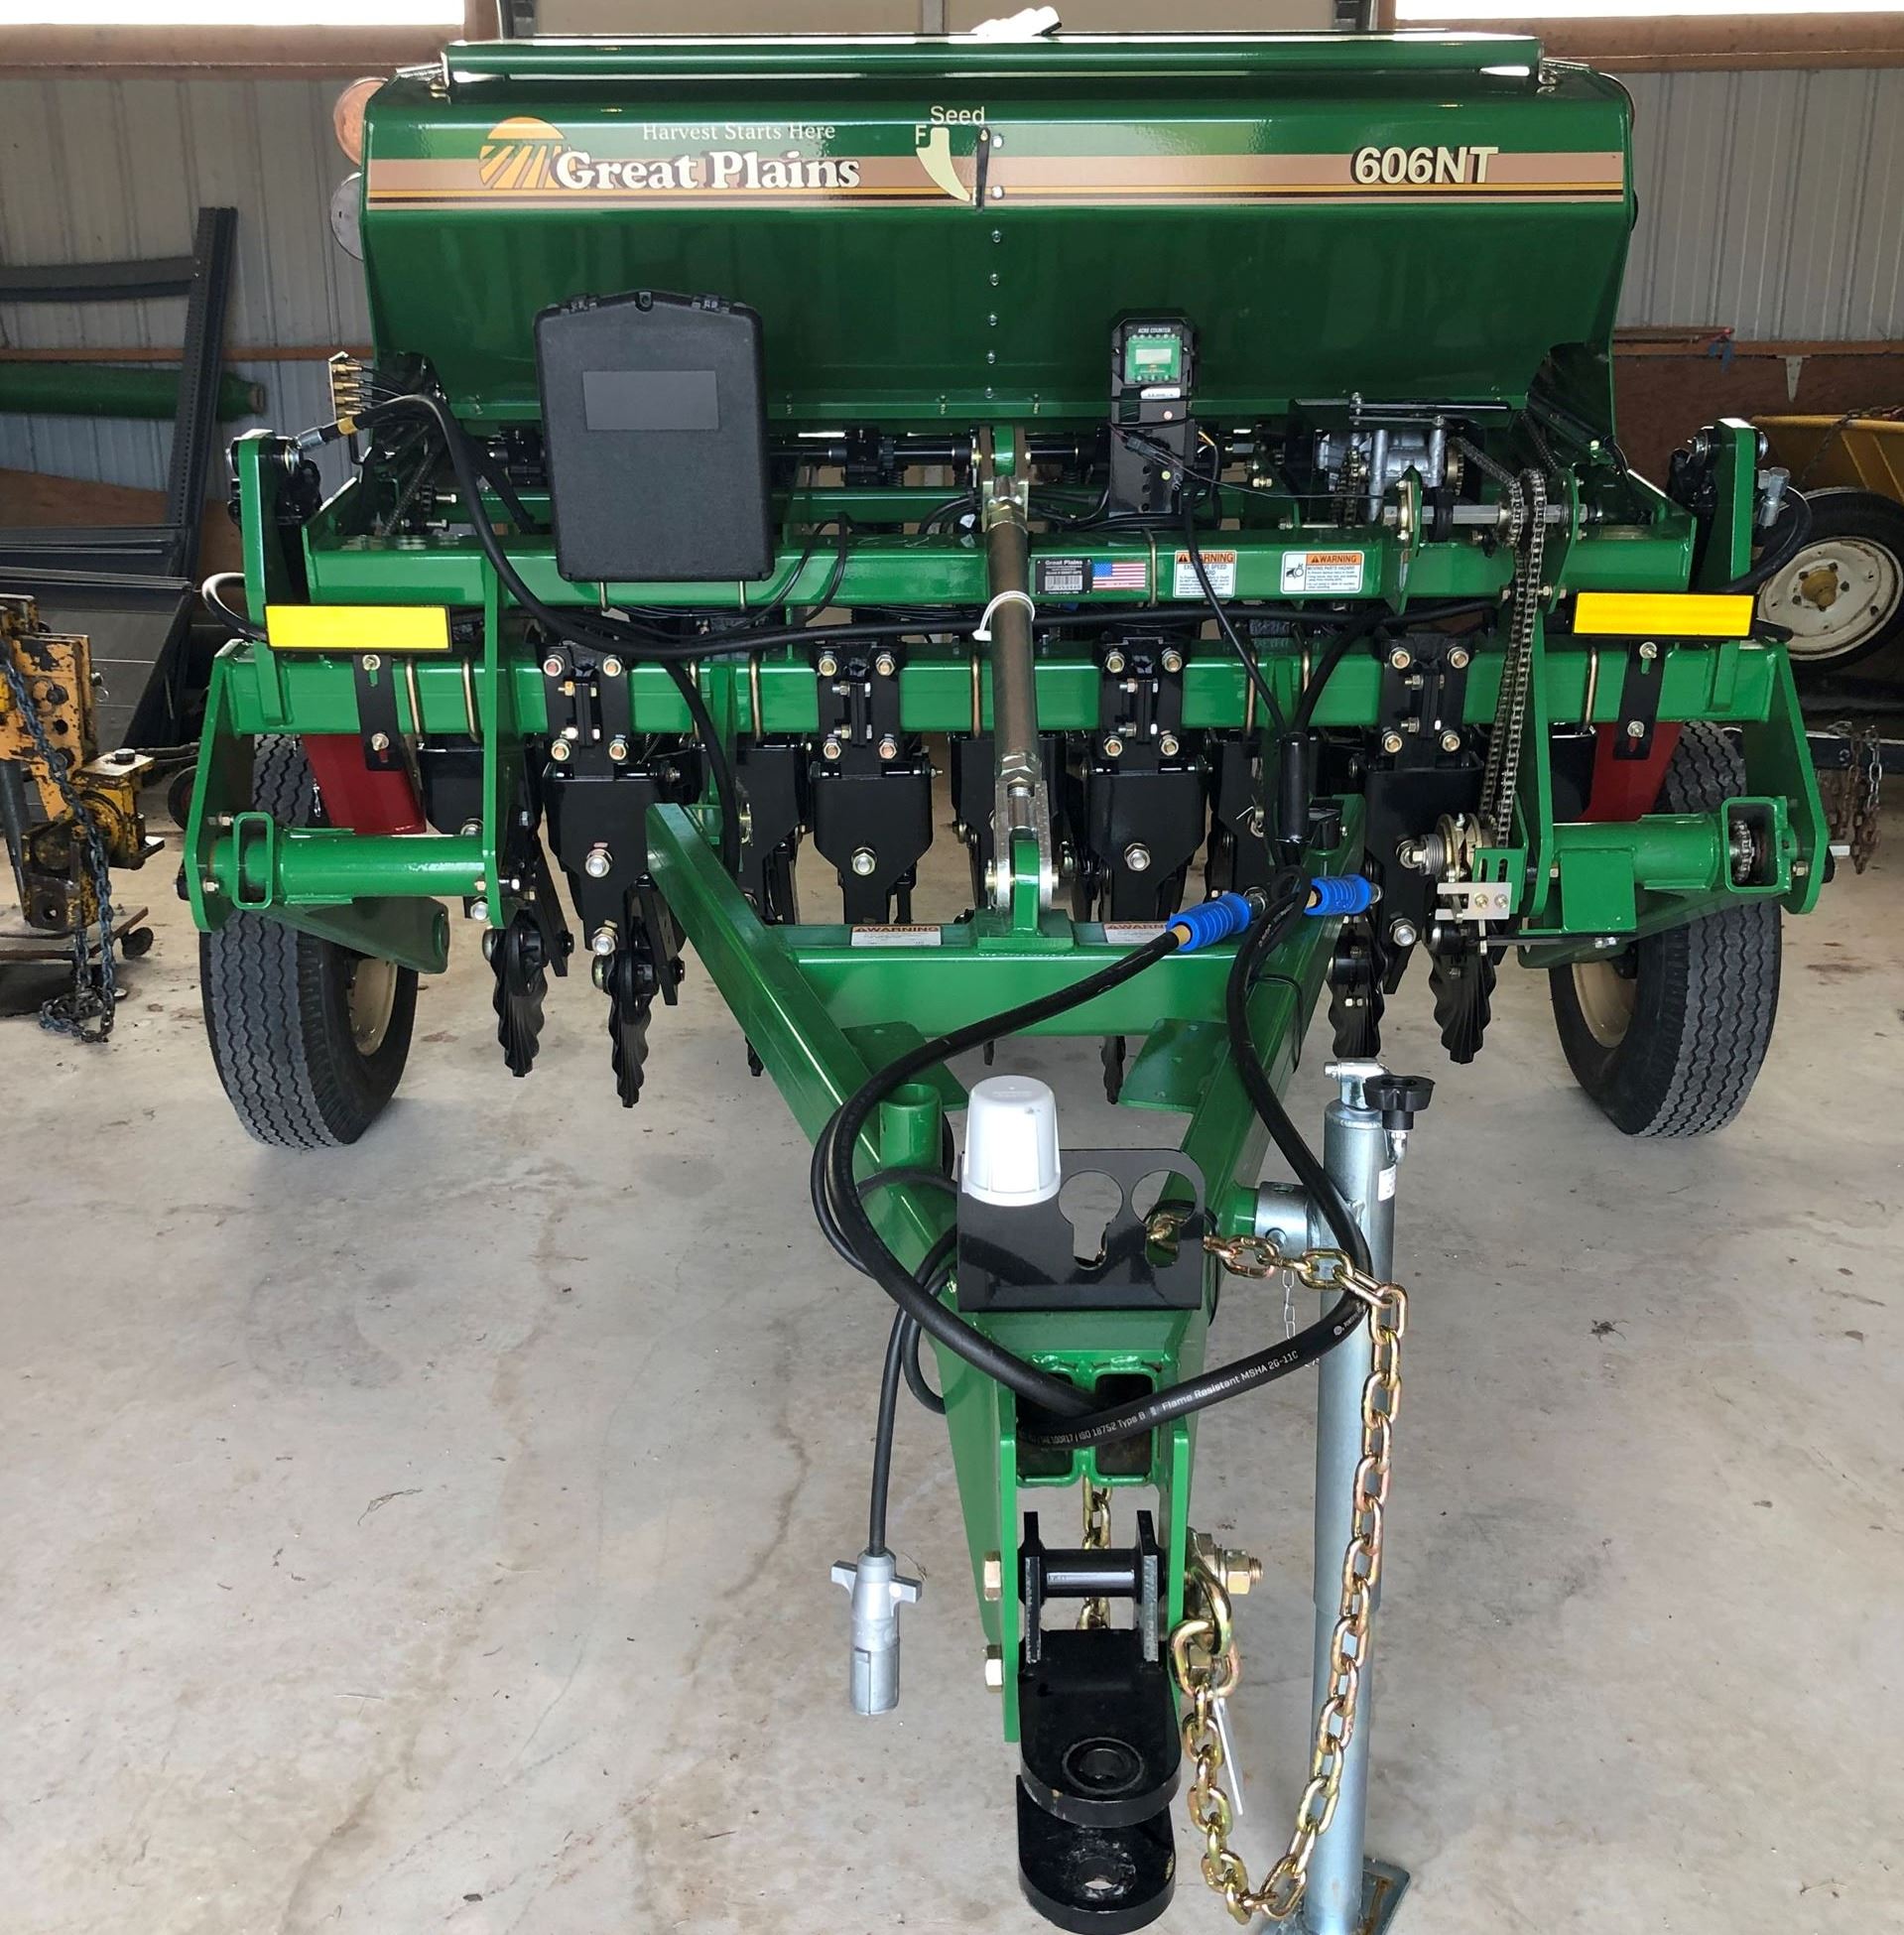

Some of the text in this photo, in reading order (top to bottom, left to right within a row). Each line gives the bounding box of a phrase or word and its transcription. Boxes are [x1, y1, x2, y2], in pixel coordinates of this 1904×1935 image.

[930, 105, 985, 125] Seed
[643, 123, 836, 140] Harvest Starts Here
[915, 124, 928, 145] F
[553, 149, 860, 190] Great Plains
[1352, 146, 1499, 185] 606NT
[1320, 555, 1357, 564] WARNING
[1091, 1421, 1117, 1438] 18752
[1117, 1414, 1138, 1431] Type
[1162, 1391, 1194, 1412] Flame
[1194, 1374, 1241, 1399] Resistant
[1241, 1363, 1269, 1384] MSHA
